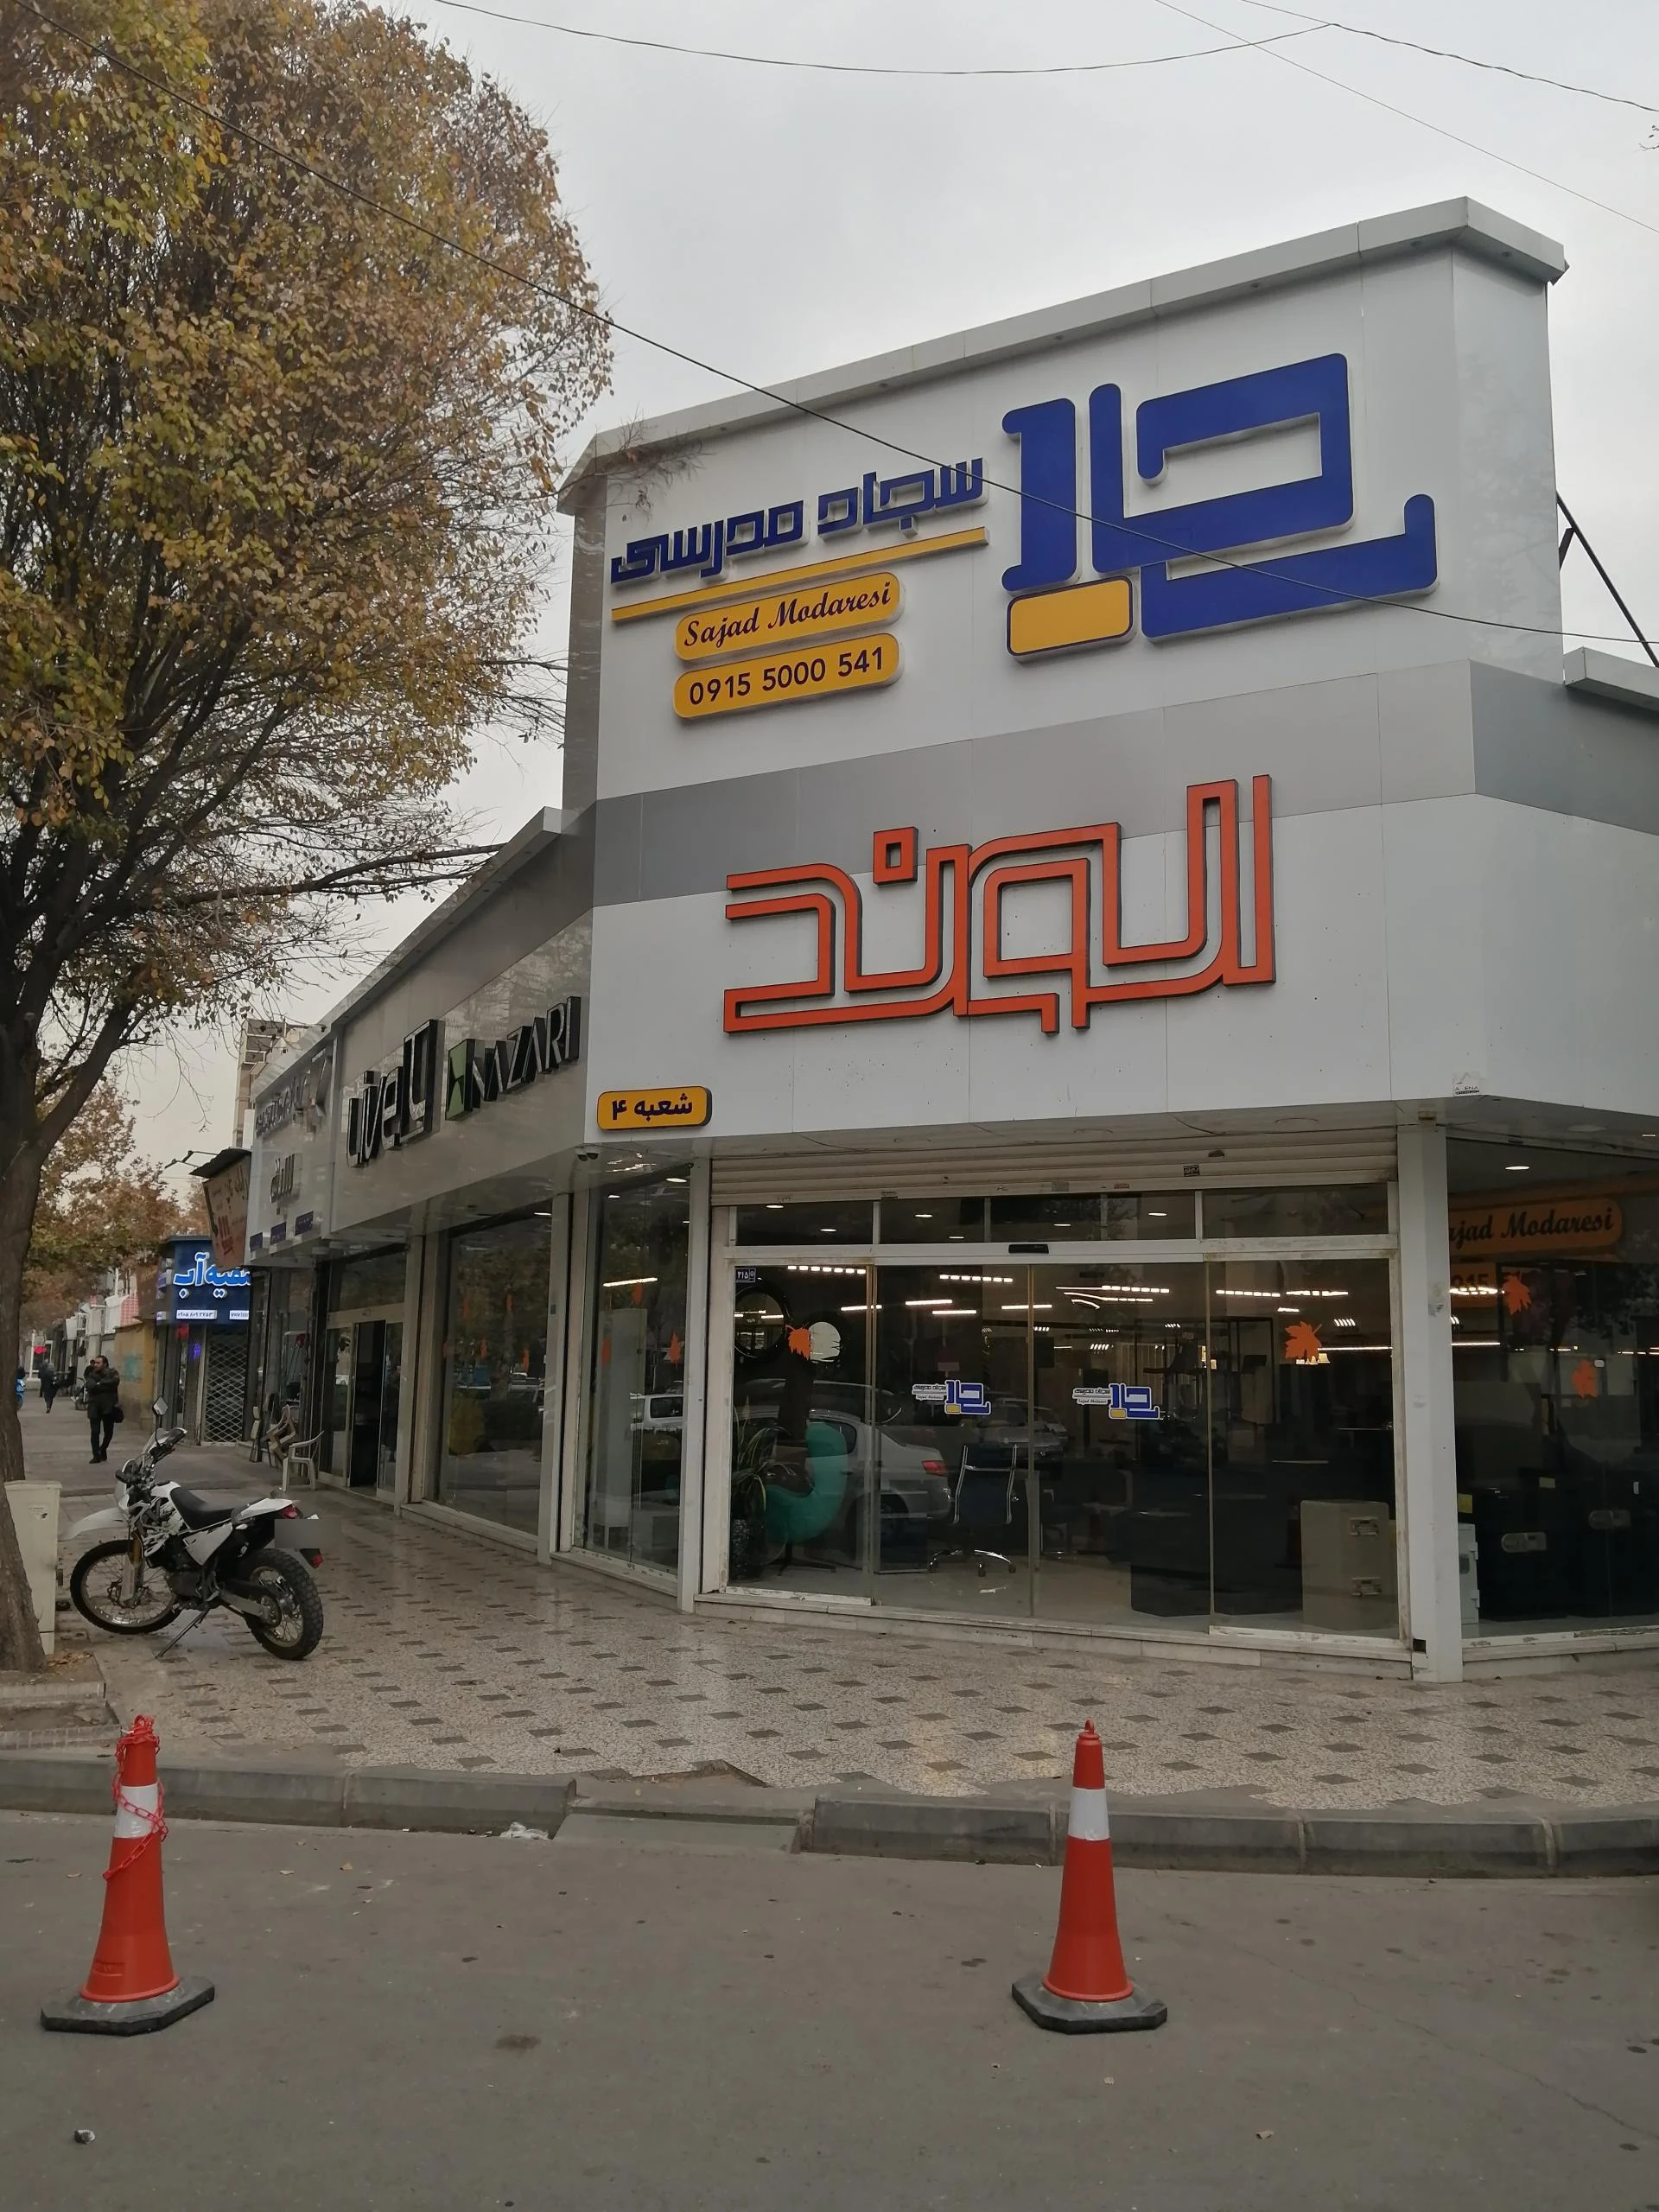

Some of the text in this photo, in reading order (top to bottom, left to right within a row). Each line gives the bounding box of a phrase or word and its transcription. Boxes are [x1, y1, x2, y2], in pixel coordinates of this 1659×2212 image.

[610, 457, 987, 585] سجاد مدرسی
[683, 581, 892, 648] Sajad Modaresi
[689, 645, 885, 705] 0915 5000 541
[723, 774, 1277, 1035] الوند
[612, 1092, 693, 1122] شعبه ۴
[1448, 1207, 1614, 1249] ajad Modaresi
[173, 1252, 210, 1300] آب
